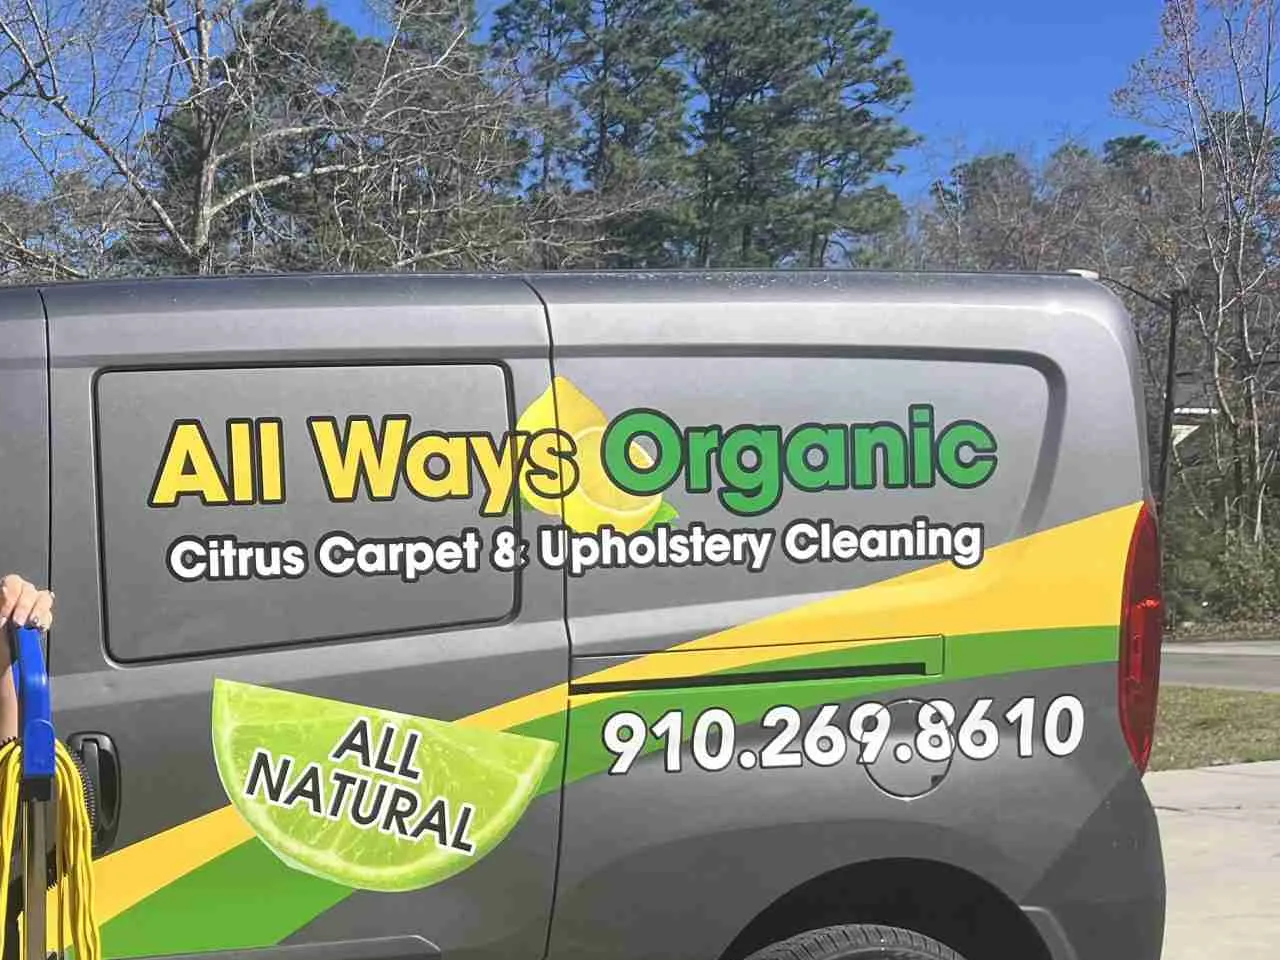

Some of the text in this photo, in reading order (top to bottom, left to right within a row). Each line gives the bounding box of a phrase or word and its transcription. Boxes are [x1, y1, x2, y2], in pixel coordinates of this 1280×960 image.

[149, 404, 997, 517] All Ways Organic
[167, 517, 984, 582] Citrus Carpet & Upholstery Cleaning
[332, 719, 421, 780] ALL
[602, 695, 1085, 775] 910.269.8610
[245, 751, 474, 853] NATURAL
